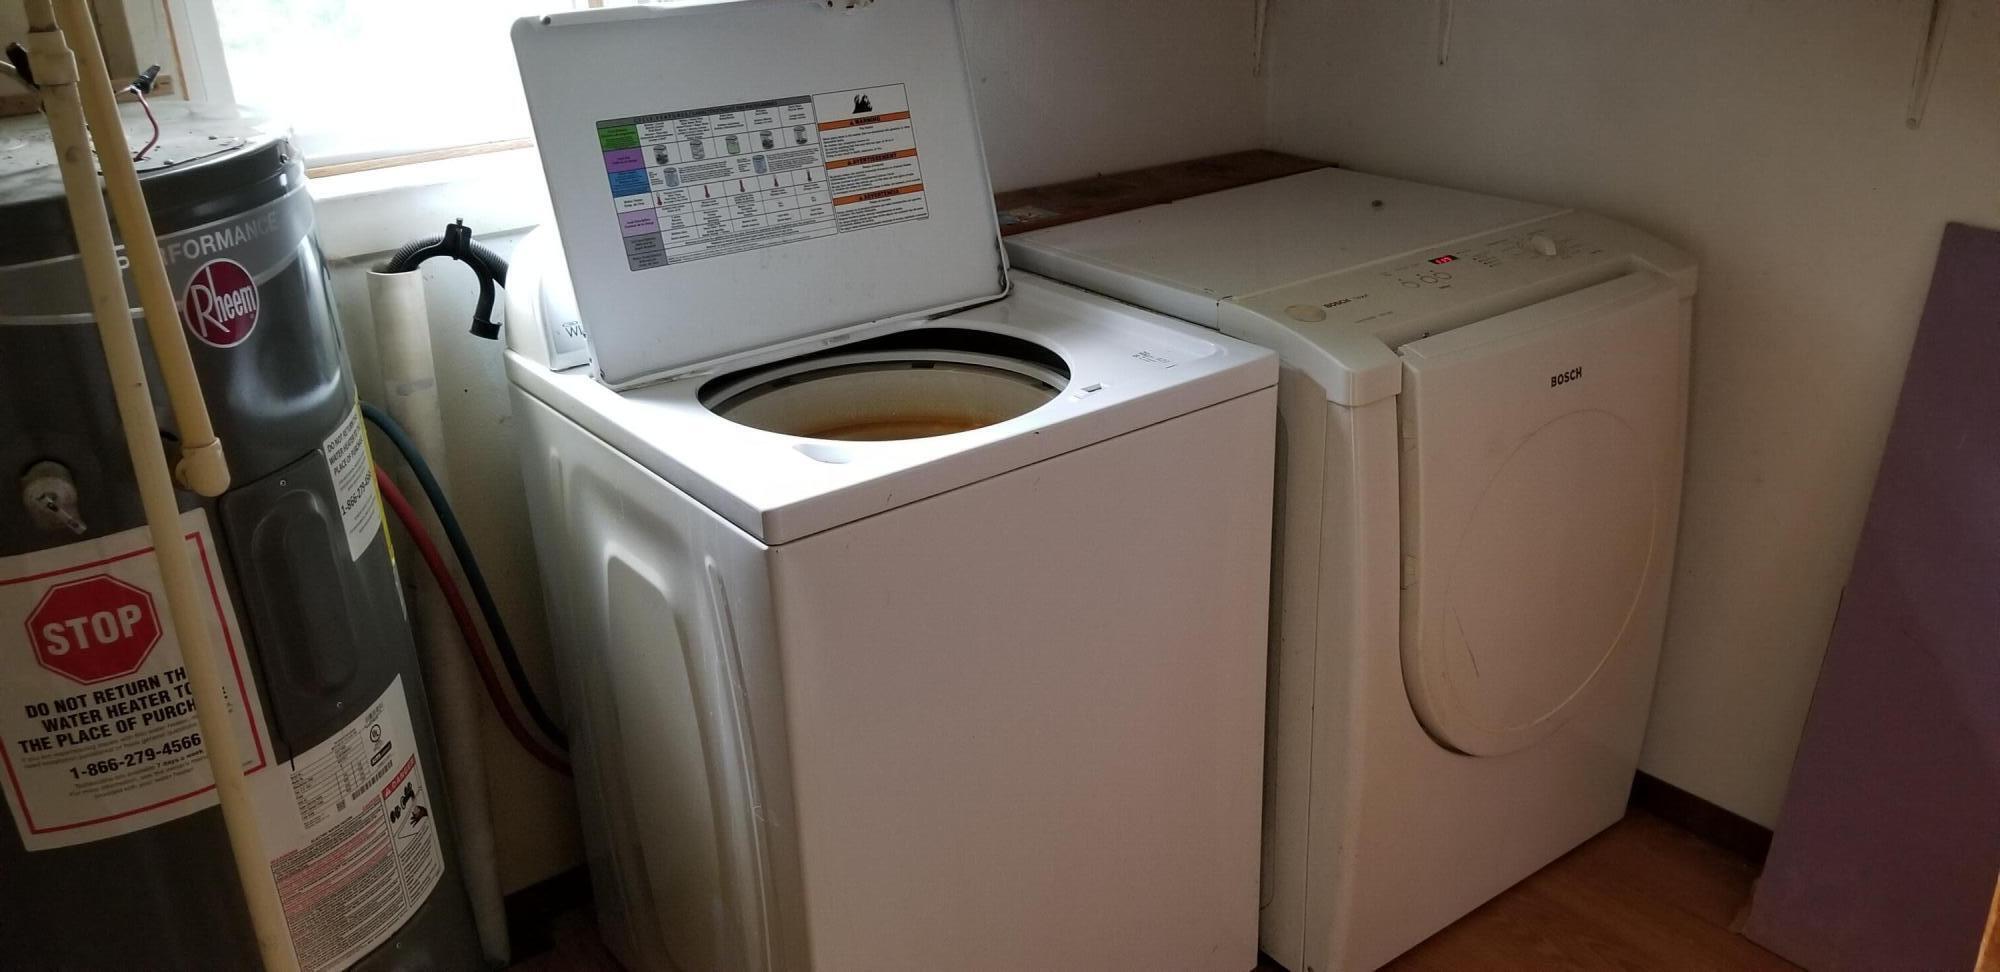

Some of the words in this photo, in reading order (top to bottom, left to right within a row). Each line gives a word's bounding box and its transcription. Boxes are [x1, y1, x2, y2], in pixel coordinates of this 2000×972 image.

[160, 212, 279, 266] RFORMANCE
[191, 266, 257, 337] Rheem
[1551, 366, 1582, 388] BOSCH
[43, 604, 142, 656] STOP
[25, 702, 50, 719] DO
[54, 694, 88, 713] NOT
[93, 675, 161, 705] RETURN
[164, 666, 187, 684] TH
[42, 709, 103, 733] WATER
[106, 690, 172, 719] HEATER
[18, 736, 54, 754] THE
[56, 724, 113, 748] PLACE
[116, 717, 137, 734] OF
[142, 699, 197, 727] PURCH
[70, 733, 202, 780] 1-866-279-4566
